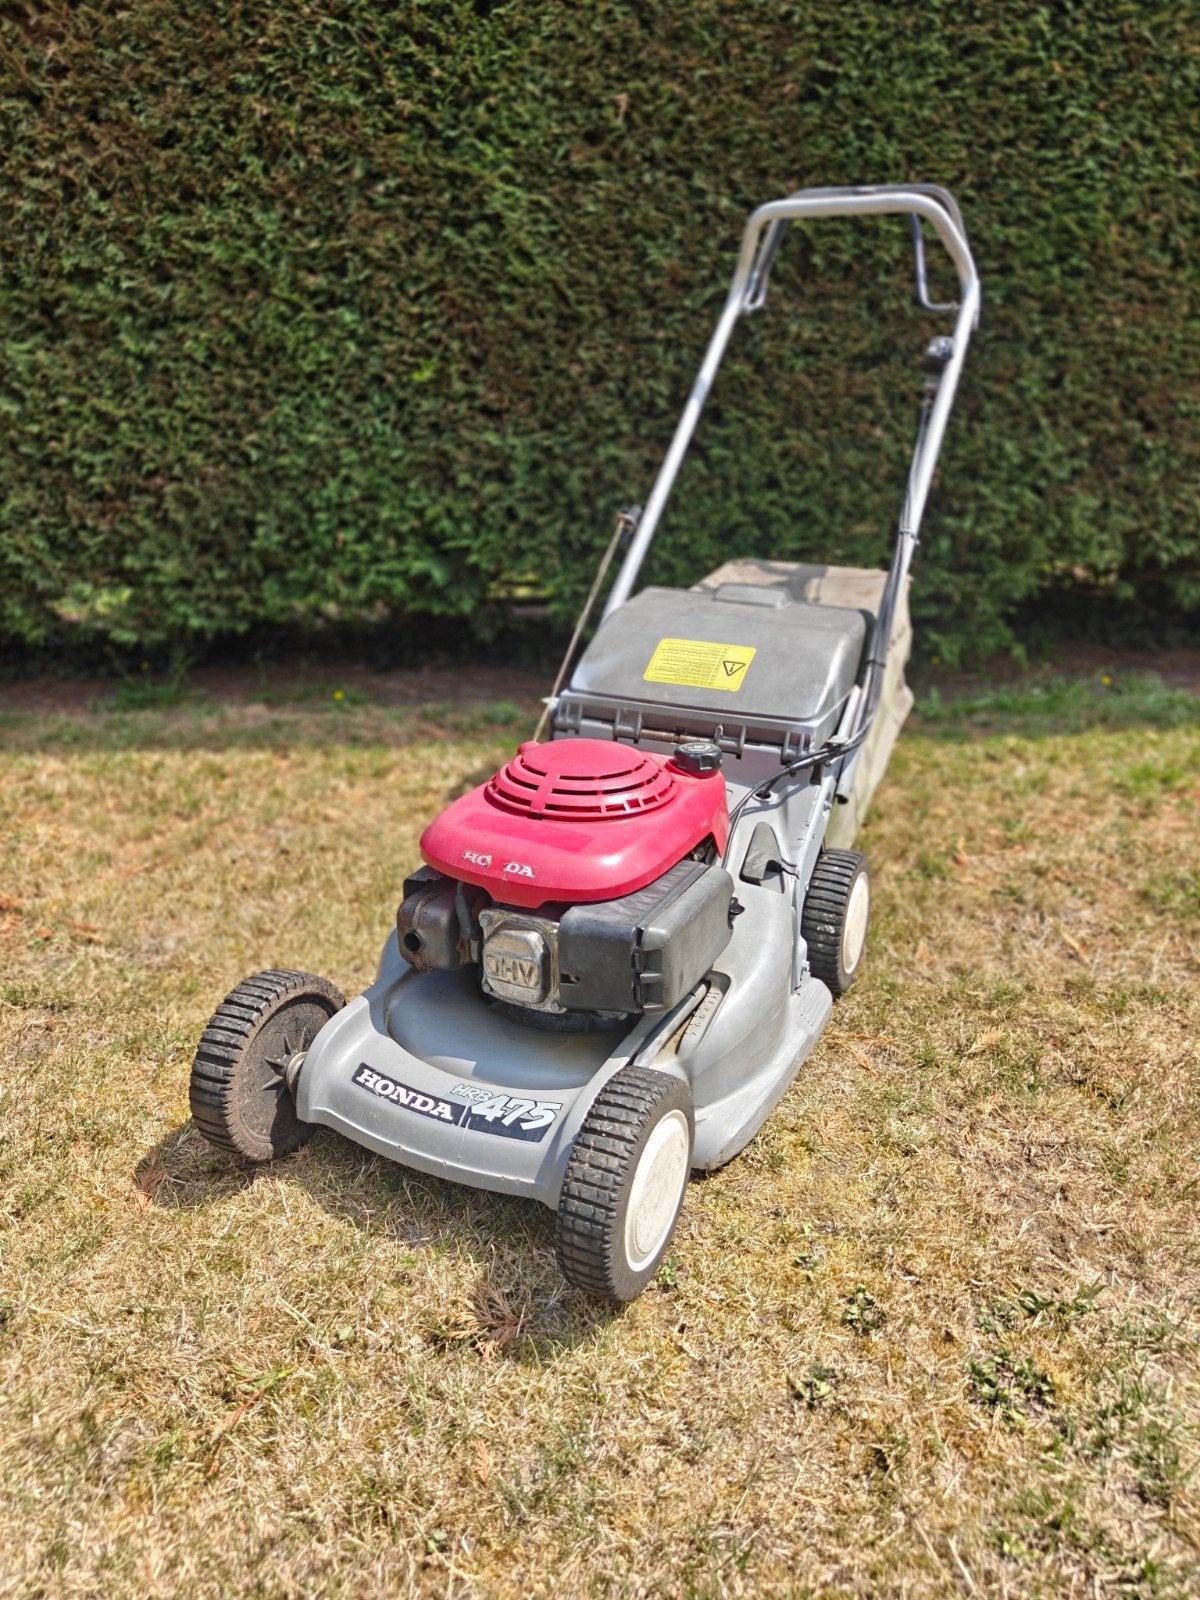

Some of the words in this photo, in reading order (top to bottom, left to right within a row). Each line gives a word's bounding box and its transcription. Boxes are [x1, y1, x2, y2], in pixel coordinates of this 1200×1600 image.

[356, 1068, 454, 1120] HONDA
[450, 1084, 494, 1102] HRB
[471, 1094, 563, 1131] 475
